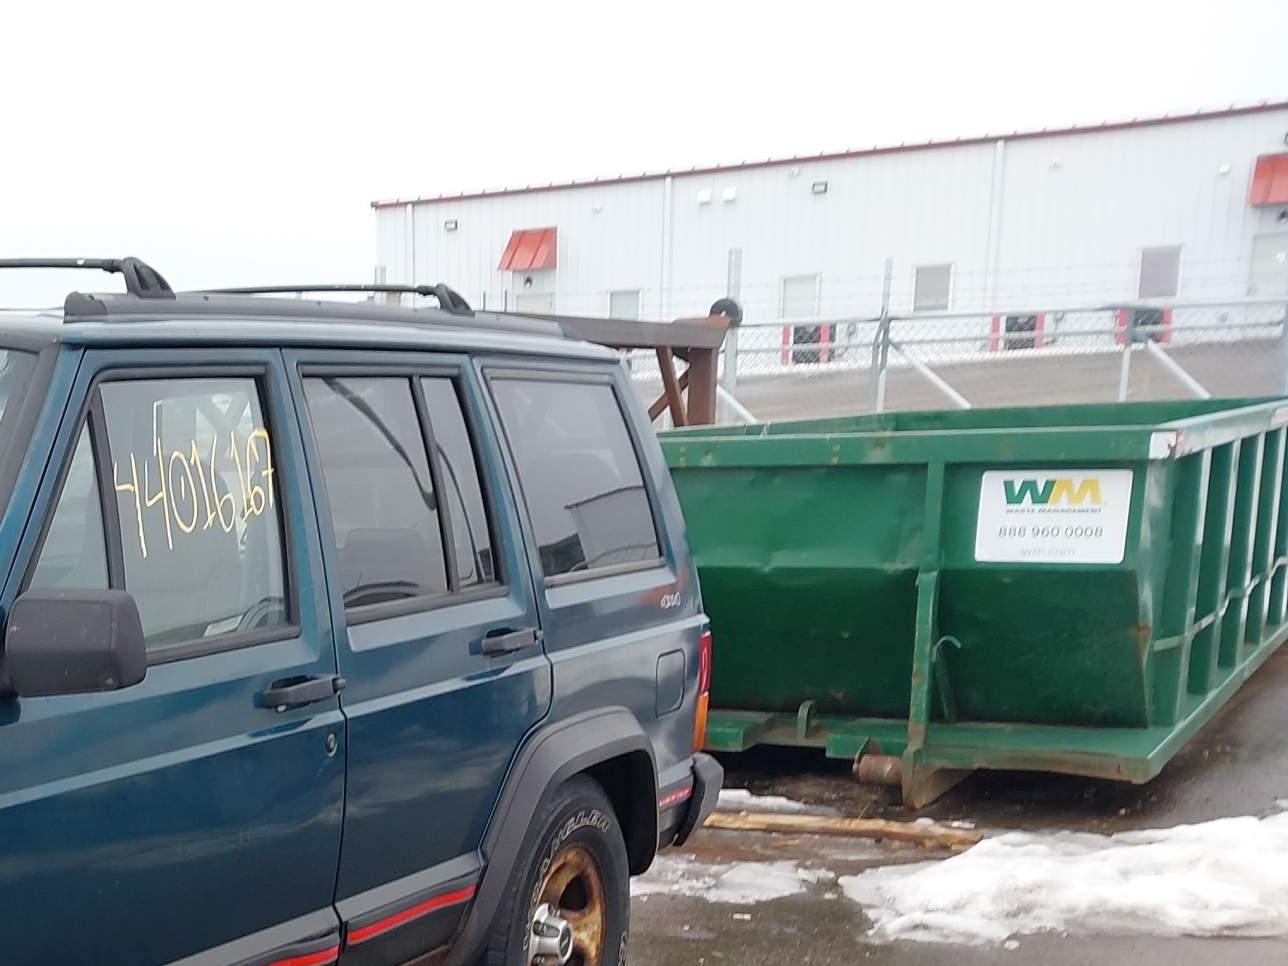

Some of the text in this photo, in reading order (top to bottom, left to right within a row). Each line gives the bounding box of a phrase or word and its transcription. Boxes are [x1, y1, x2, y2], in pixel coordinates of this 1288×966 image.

[114, 428, 275, 558] 44016167
[1003, 479, 1103, 505] WM
[998, 525, 1027, 538] 888
[1031, 525, 1061, 538] 960
